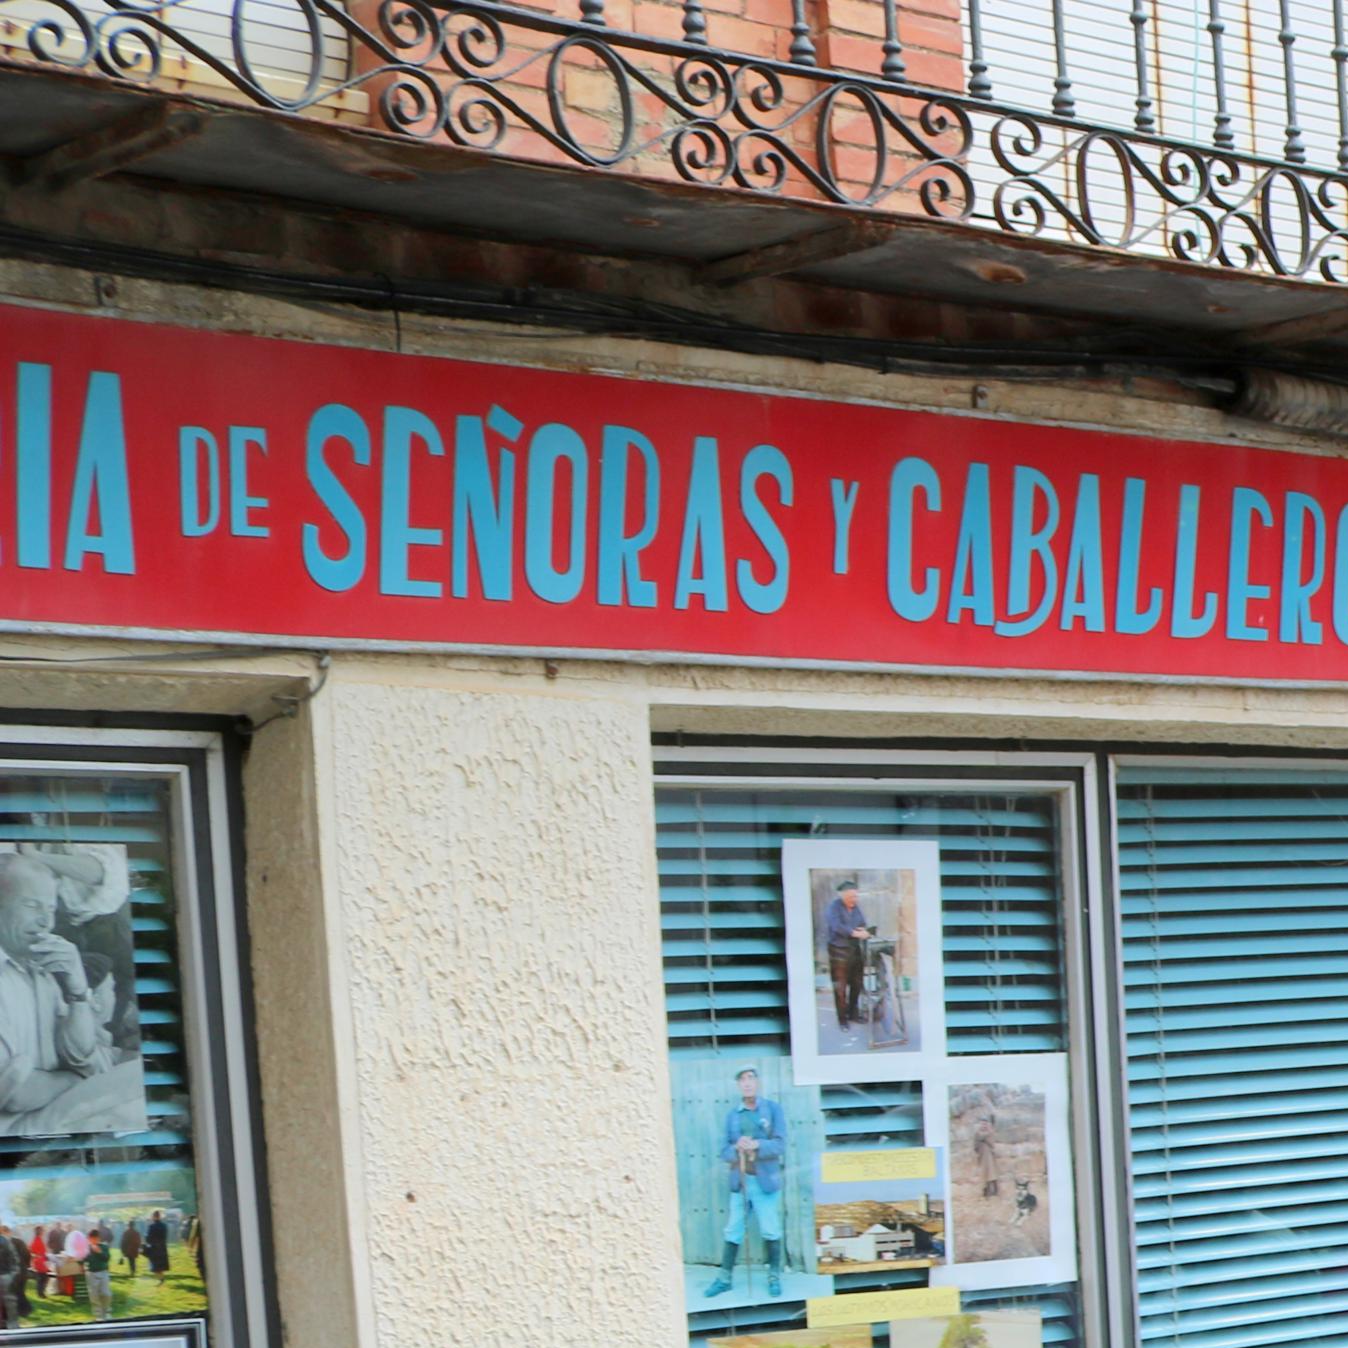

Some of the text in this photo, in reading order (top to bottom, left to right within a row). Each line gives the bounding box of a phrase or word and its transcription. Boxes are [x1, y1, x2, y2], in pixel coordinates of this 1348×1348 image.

[0, 361, 136, 576] IA
[179, 425, 271, 539] DE
[302, 403, 795, 616] SEÑORAS
[831, 478, 859, 575] Y
